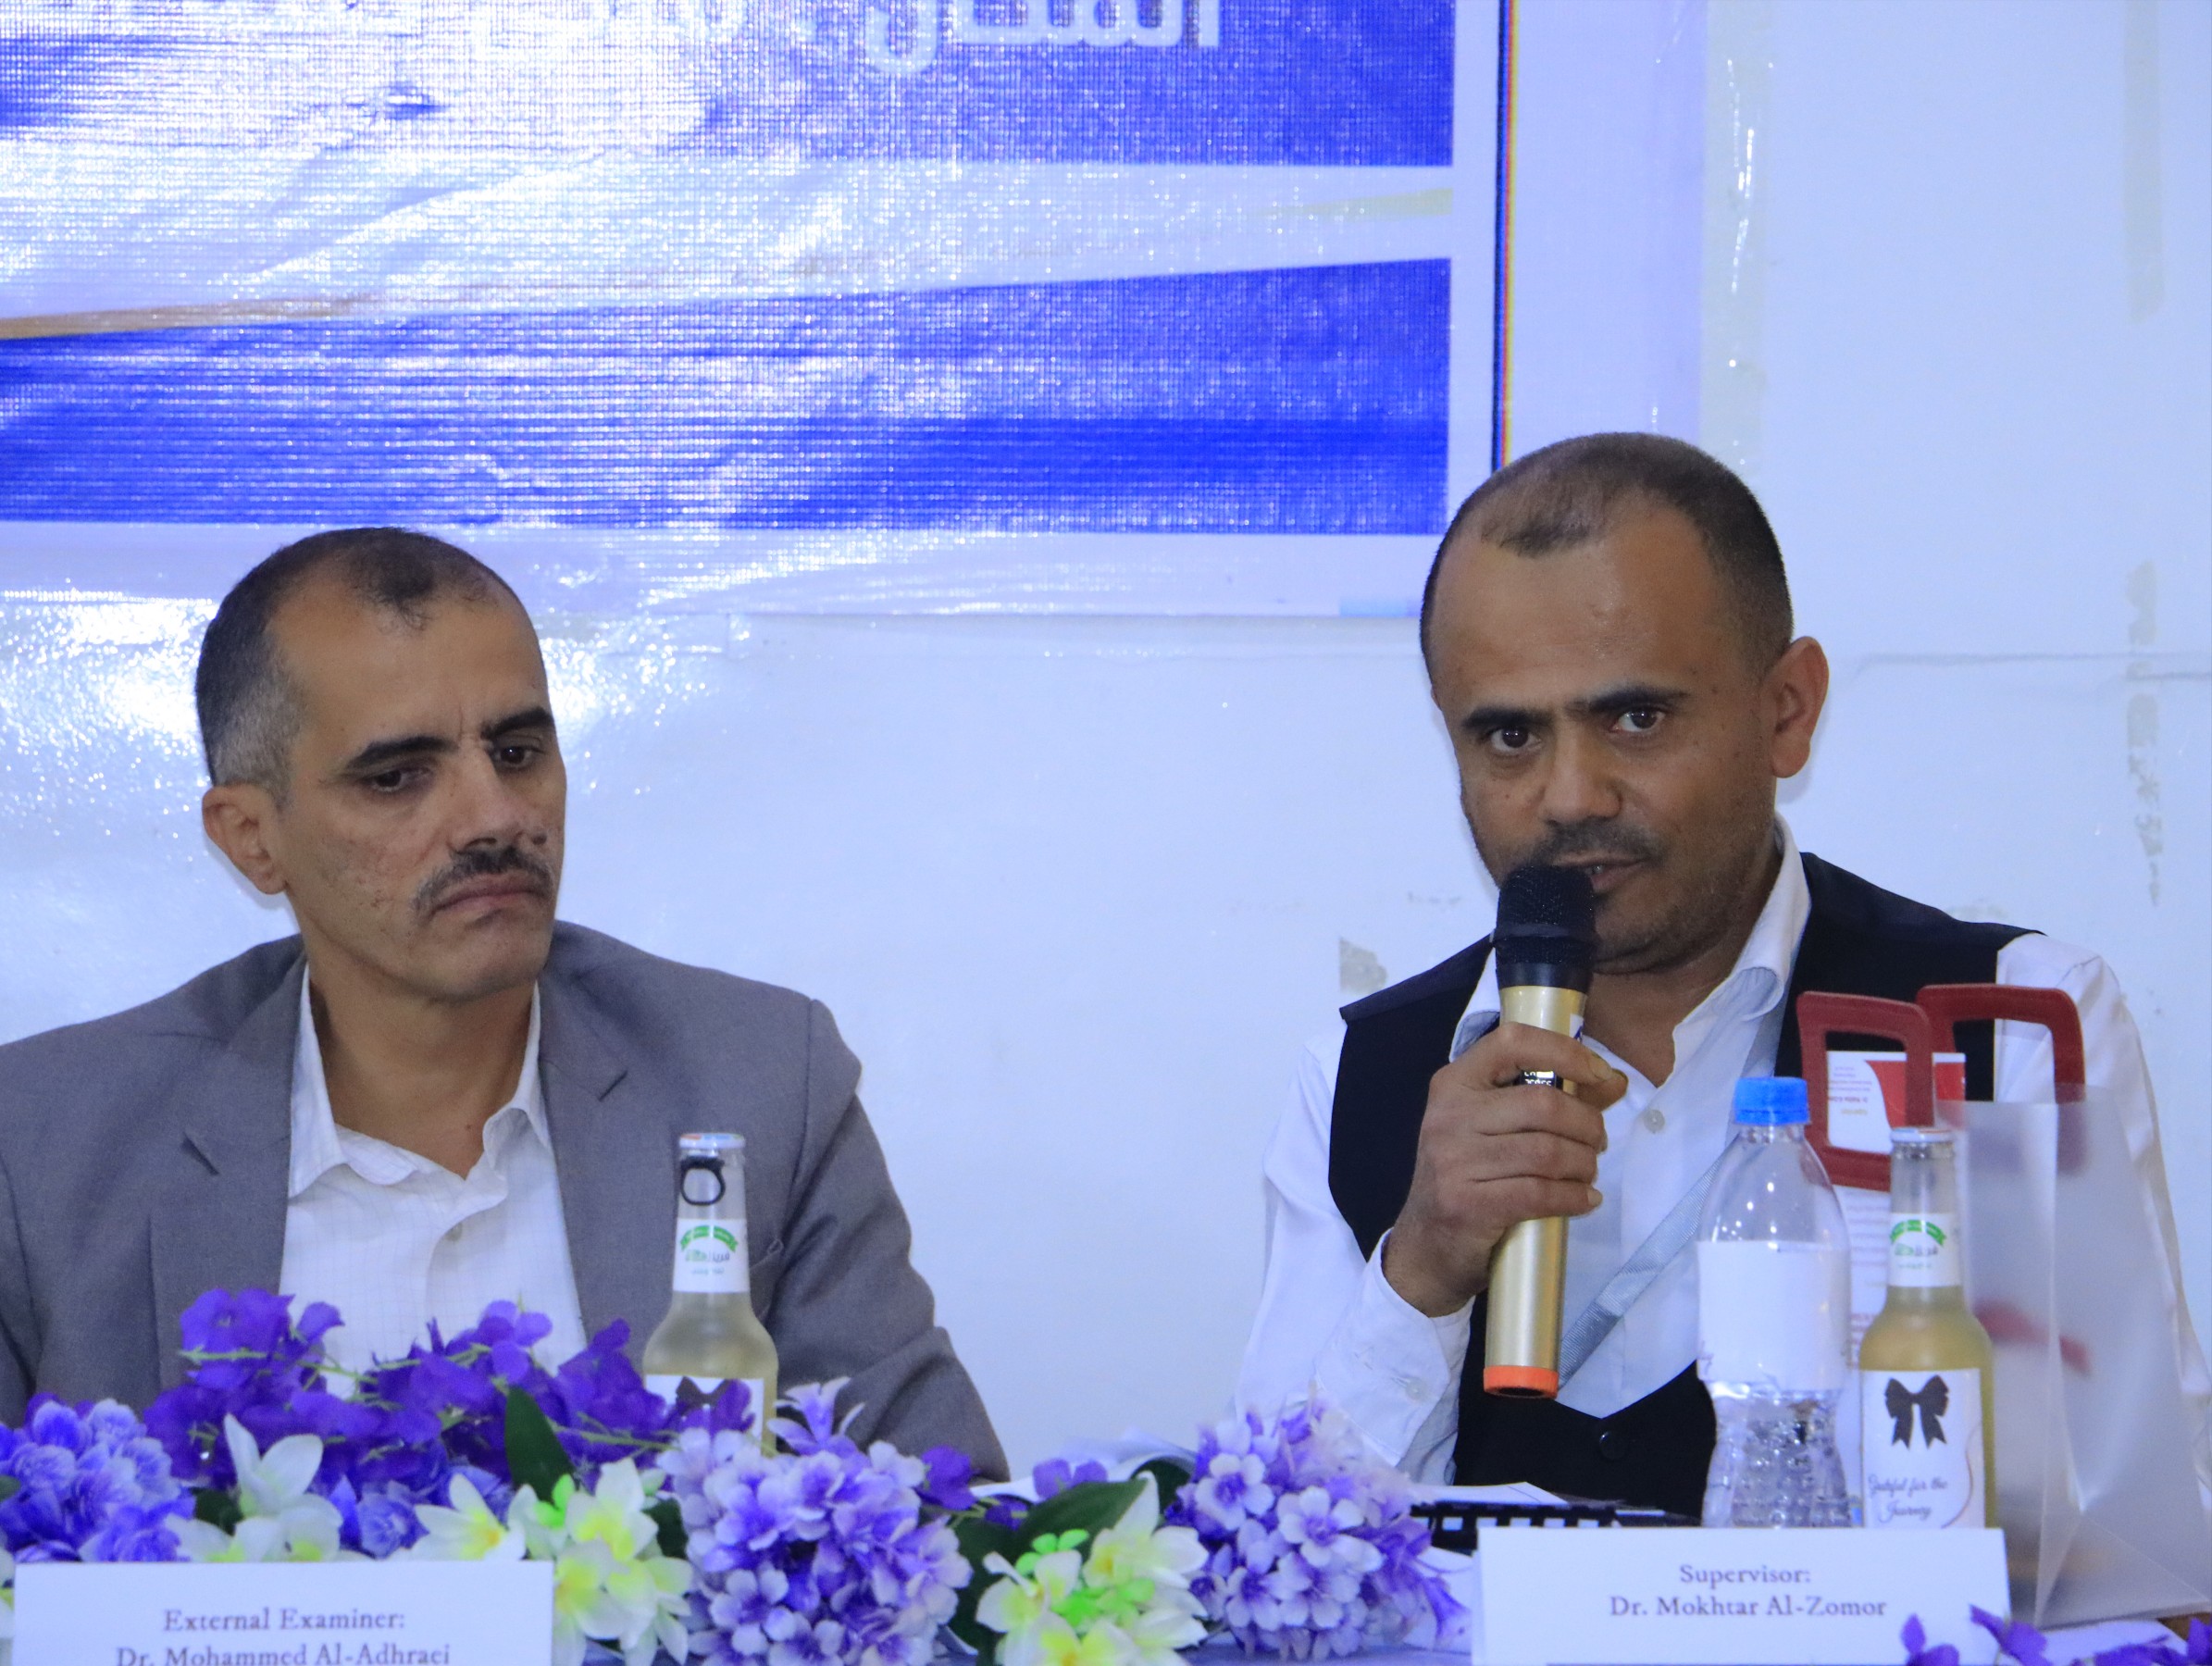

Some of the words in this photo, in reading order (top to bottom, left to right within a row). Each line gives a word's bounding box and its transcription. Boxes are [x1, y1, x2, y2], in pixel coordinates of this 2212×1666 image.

[1679, 1564, 1811, 1590] Supervisor:
[1610, 1596, 1647, 1616] Dr.
[1656, 1595, 1759, 1616] Mokhtar
[1766, 1594, 1887, 1616] Al-Zomor
[163, 1607, 271, 1632] External
[279, 1607, 405, 1632] Examiner:
[116, 1647, 155, 1666] Dr.
[164, 1644, 307, 1666] Mohammed
[314, 1642, 451, 1666] Al-Adhraei
